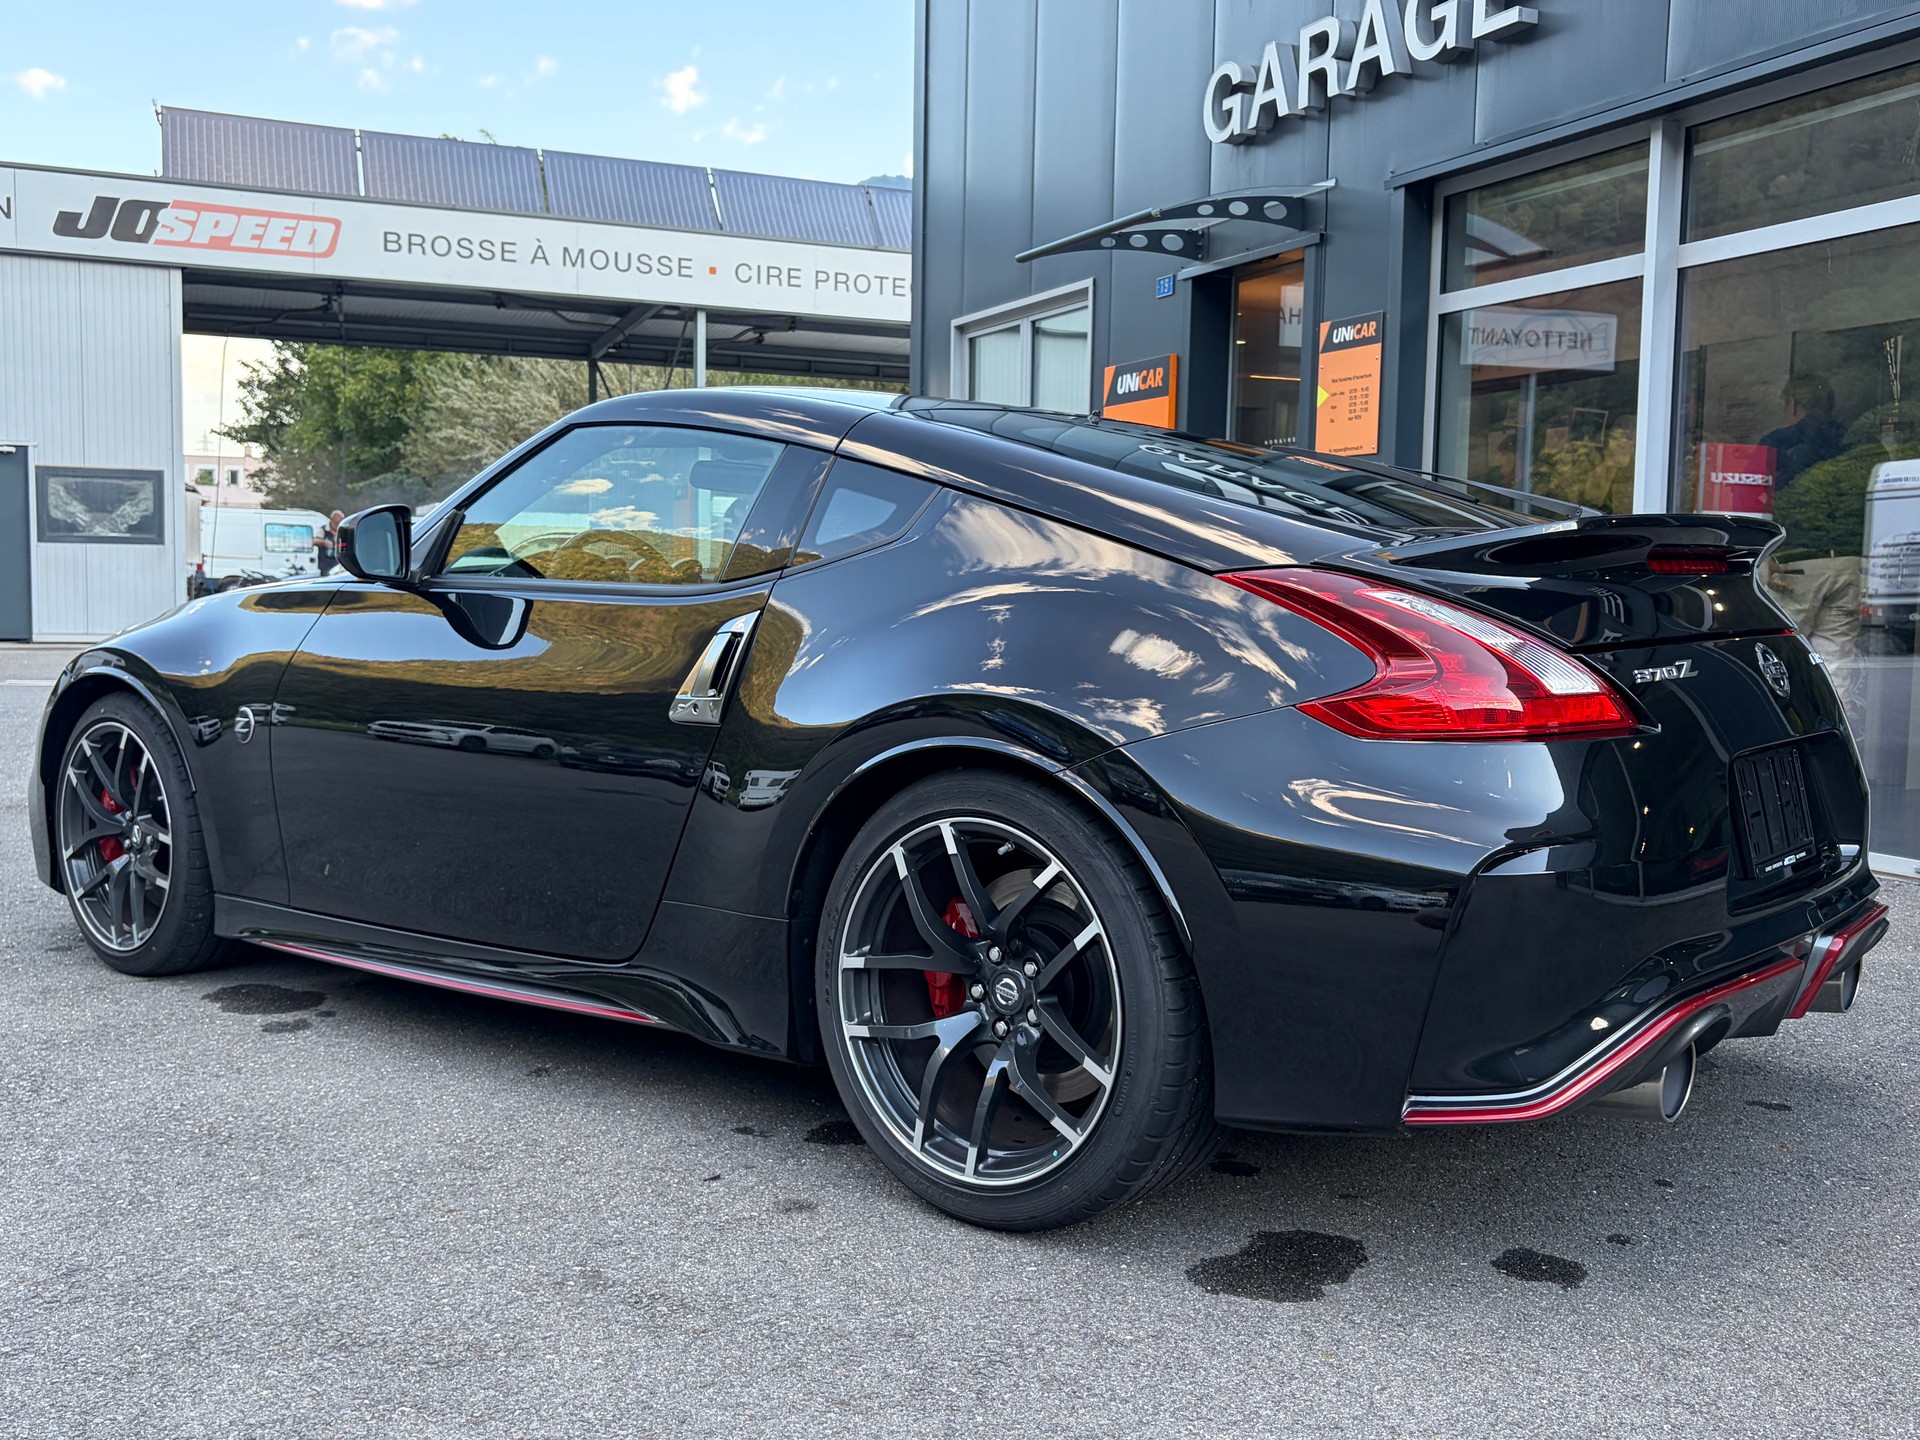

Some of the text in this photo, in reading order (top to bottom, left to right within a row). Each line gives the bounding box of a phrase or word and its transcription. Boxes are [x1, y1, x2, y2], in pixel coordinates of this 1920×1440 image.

[382, 231, 912, 298] BROSSE À MOUSSE CIRE PROTE
[1633, 659, 1699, 684] 370Z
